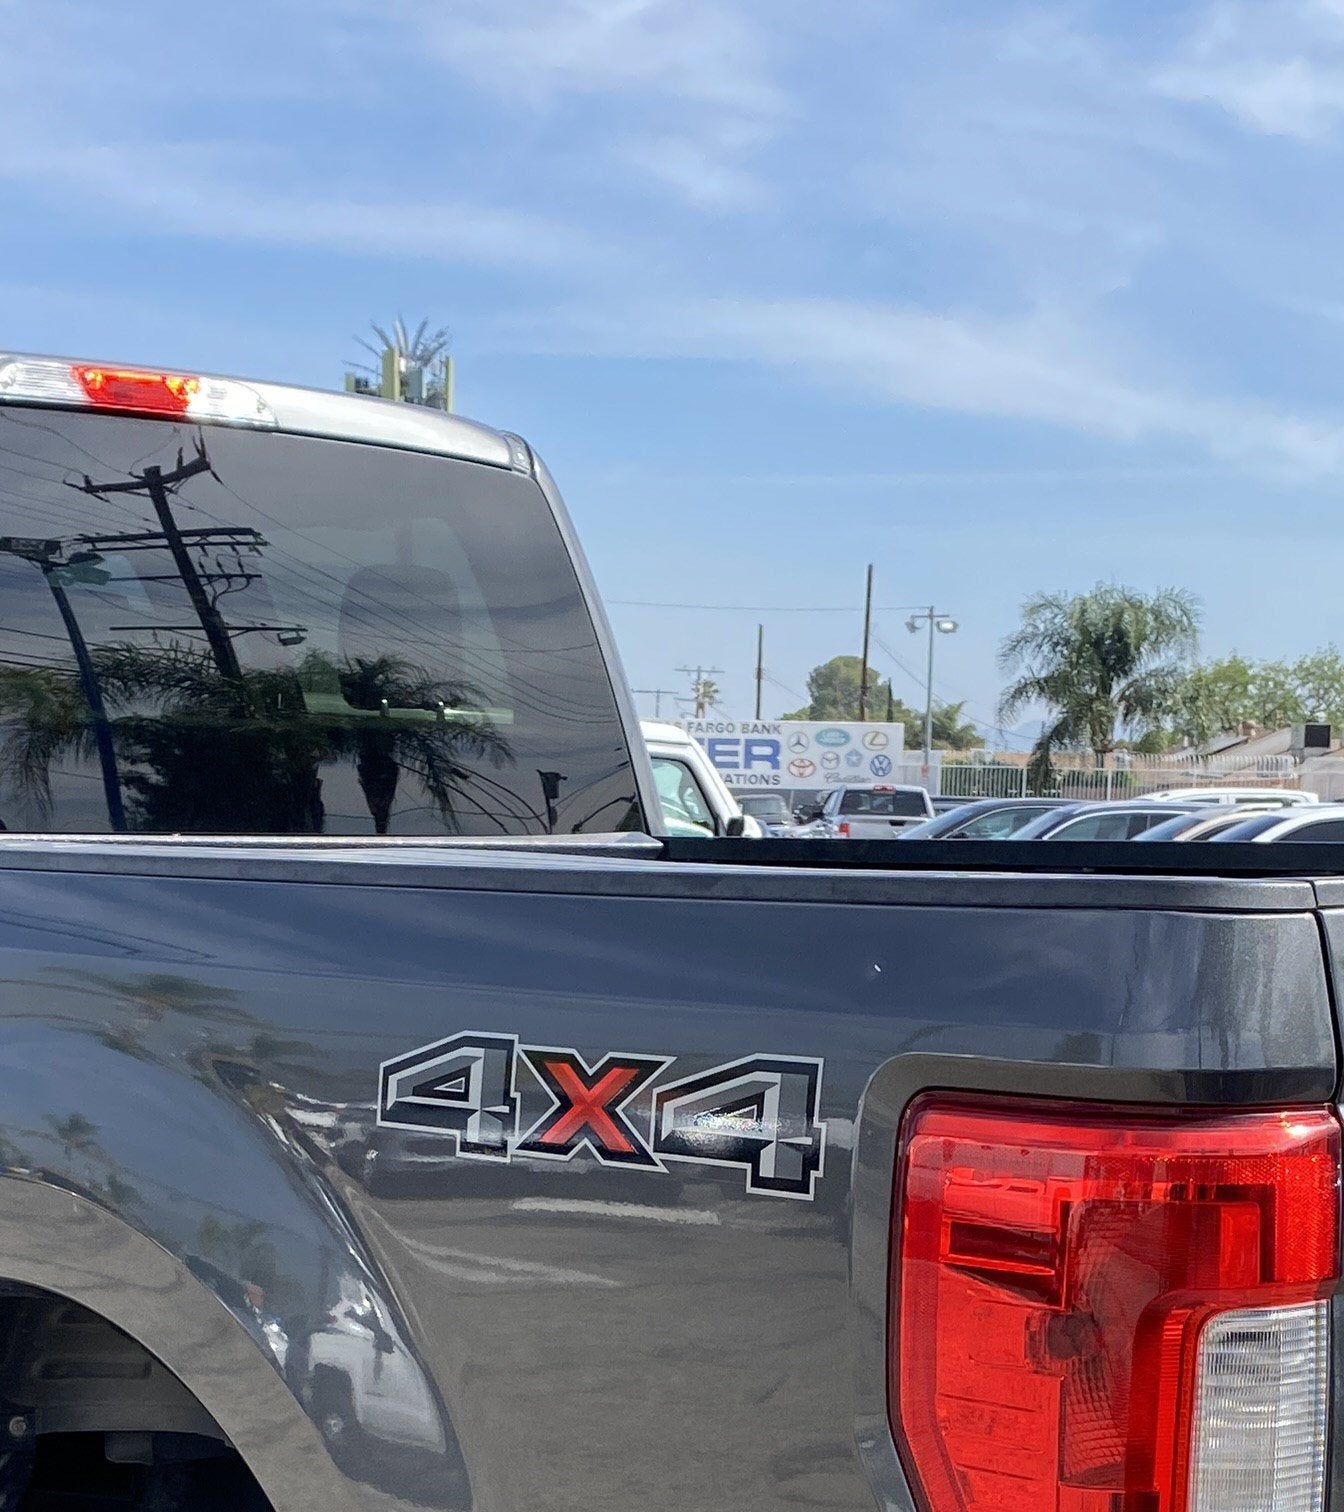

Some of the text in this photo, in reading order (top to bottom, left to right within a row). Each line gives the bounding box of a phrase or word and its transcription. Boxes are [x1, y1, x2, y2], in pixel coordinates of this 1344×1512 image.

[687, 721, 735, 734] FARGO
[741, 723, 782, 735] BANK
[693, 738, 780, 770] ER
[723, 774, 781, 786] ATIONS
[376, 1029, 827, 1200] 4X4
